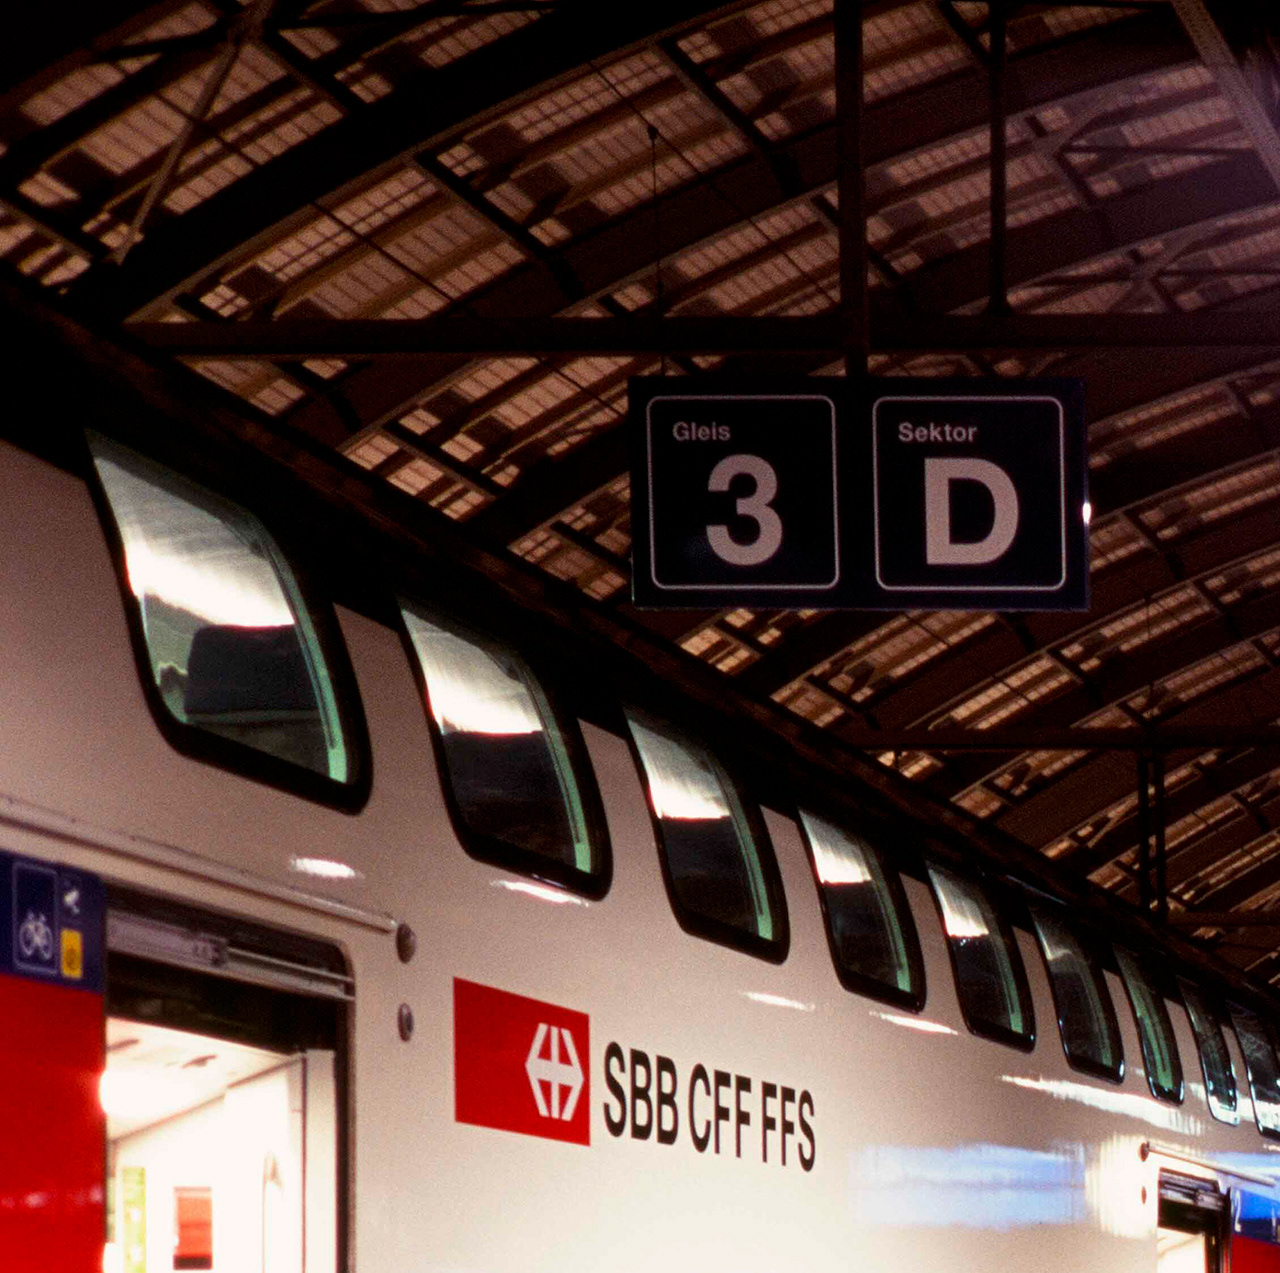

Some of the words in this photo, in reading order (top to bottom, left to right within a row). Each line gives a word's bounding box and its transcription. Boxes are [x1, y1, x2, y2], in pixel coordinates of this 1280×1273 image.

[672, 421, 731, 442] Gleis
[898, 421, 979, 443] Sektor
[706, 454, 783, 567] 3
[923, 457, 1020, 565] D
[603, 1041, 679, 1146] SBB
[688, 1062, 752, 1159] CFF
[761, 1079, 816, 1173] FFS
